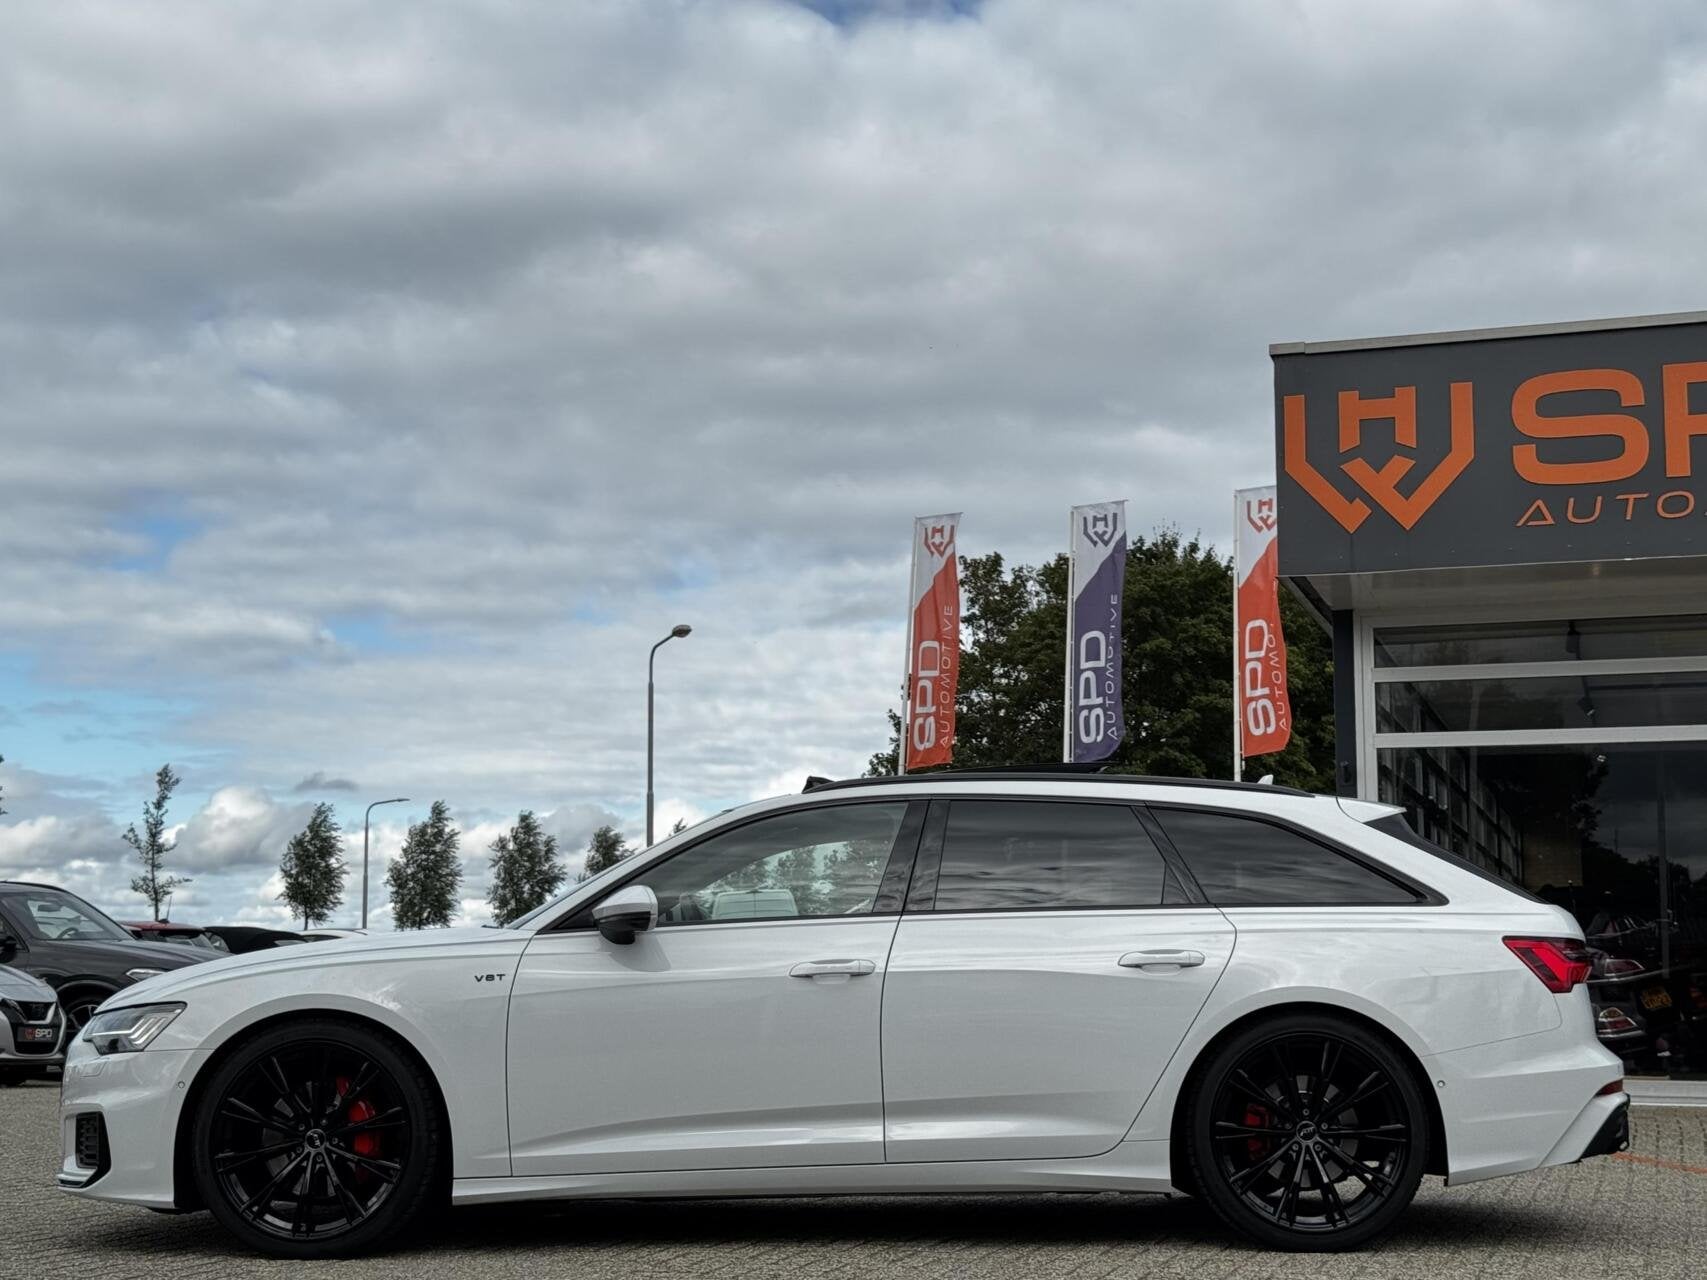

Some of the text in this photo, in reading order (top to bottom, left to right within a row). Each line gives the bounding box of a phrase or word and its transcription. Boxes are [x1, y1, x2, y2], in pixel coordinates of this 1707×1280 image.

[1516, 490, 1707, 527] AUTO
[913, 640, 940, 751] SPD
[940, 605, 953, 748] AUTOMOTIVE
[1078, 630, 1106, 744] SPD
[1245, 618, 1276, 736] SPD
[474, 973, 506, 983] V8T
